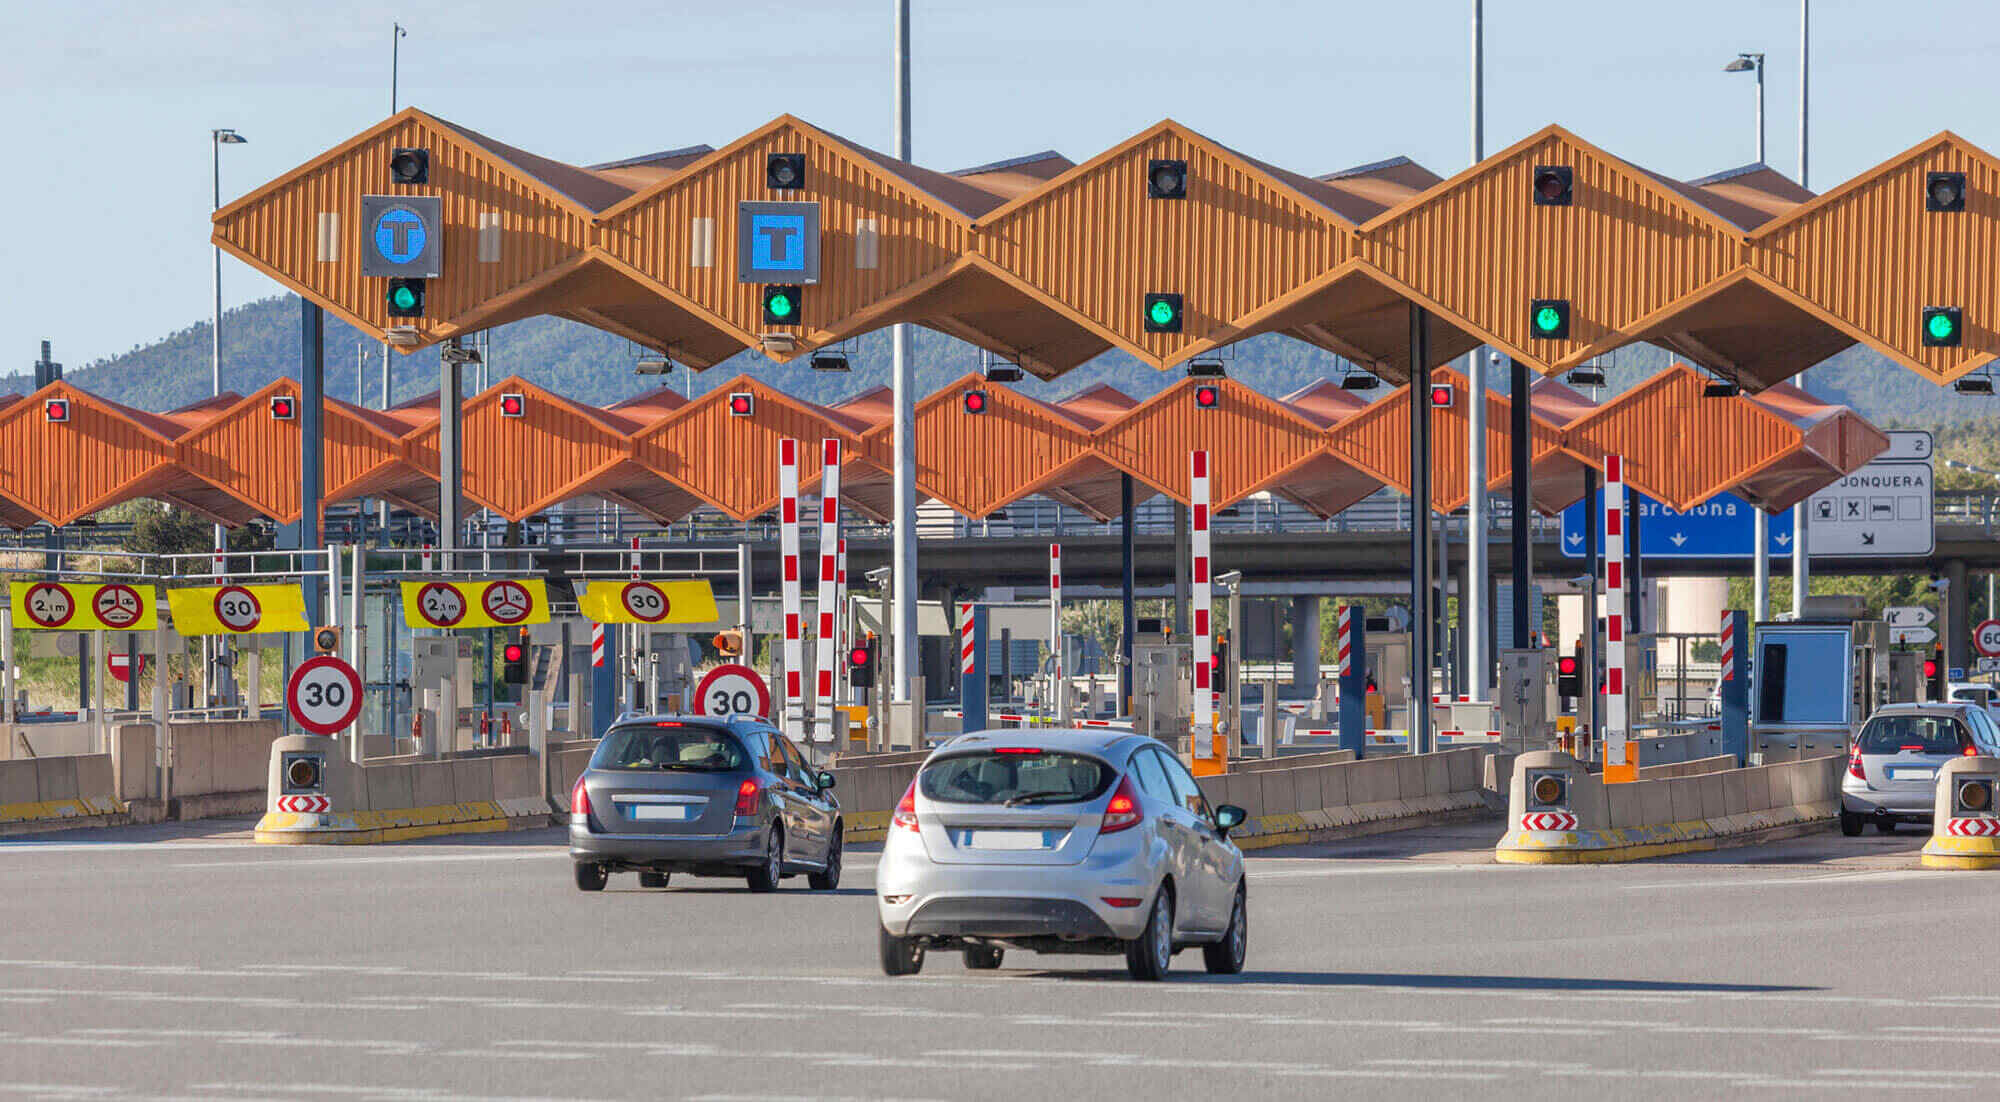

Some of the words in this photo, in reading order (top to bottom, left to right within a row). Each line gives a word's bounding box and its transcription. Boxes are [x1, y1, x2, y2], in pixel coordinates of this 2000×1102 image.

[382, 221, 419, 255] T
[759, 227, 798, 261] T
[1914, 440, 1924, 451] 2
[1840, 476, 1924, 488] JONQUERA
[224, 600, 252, 616] 30
[631, 594, 660, 609] 30
[1917, 612, 1925, 621] 2
[305, 682, 346, 707] 30
[711, 690, 752, 715] 30
